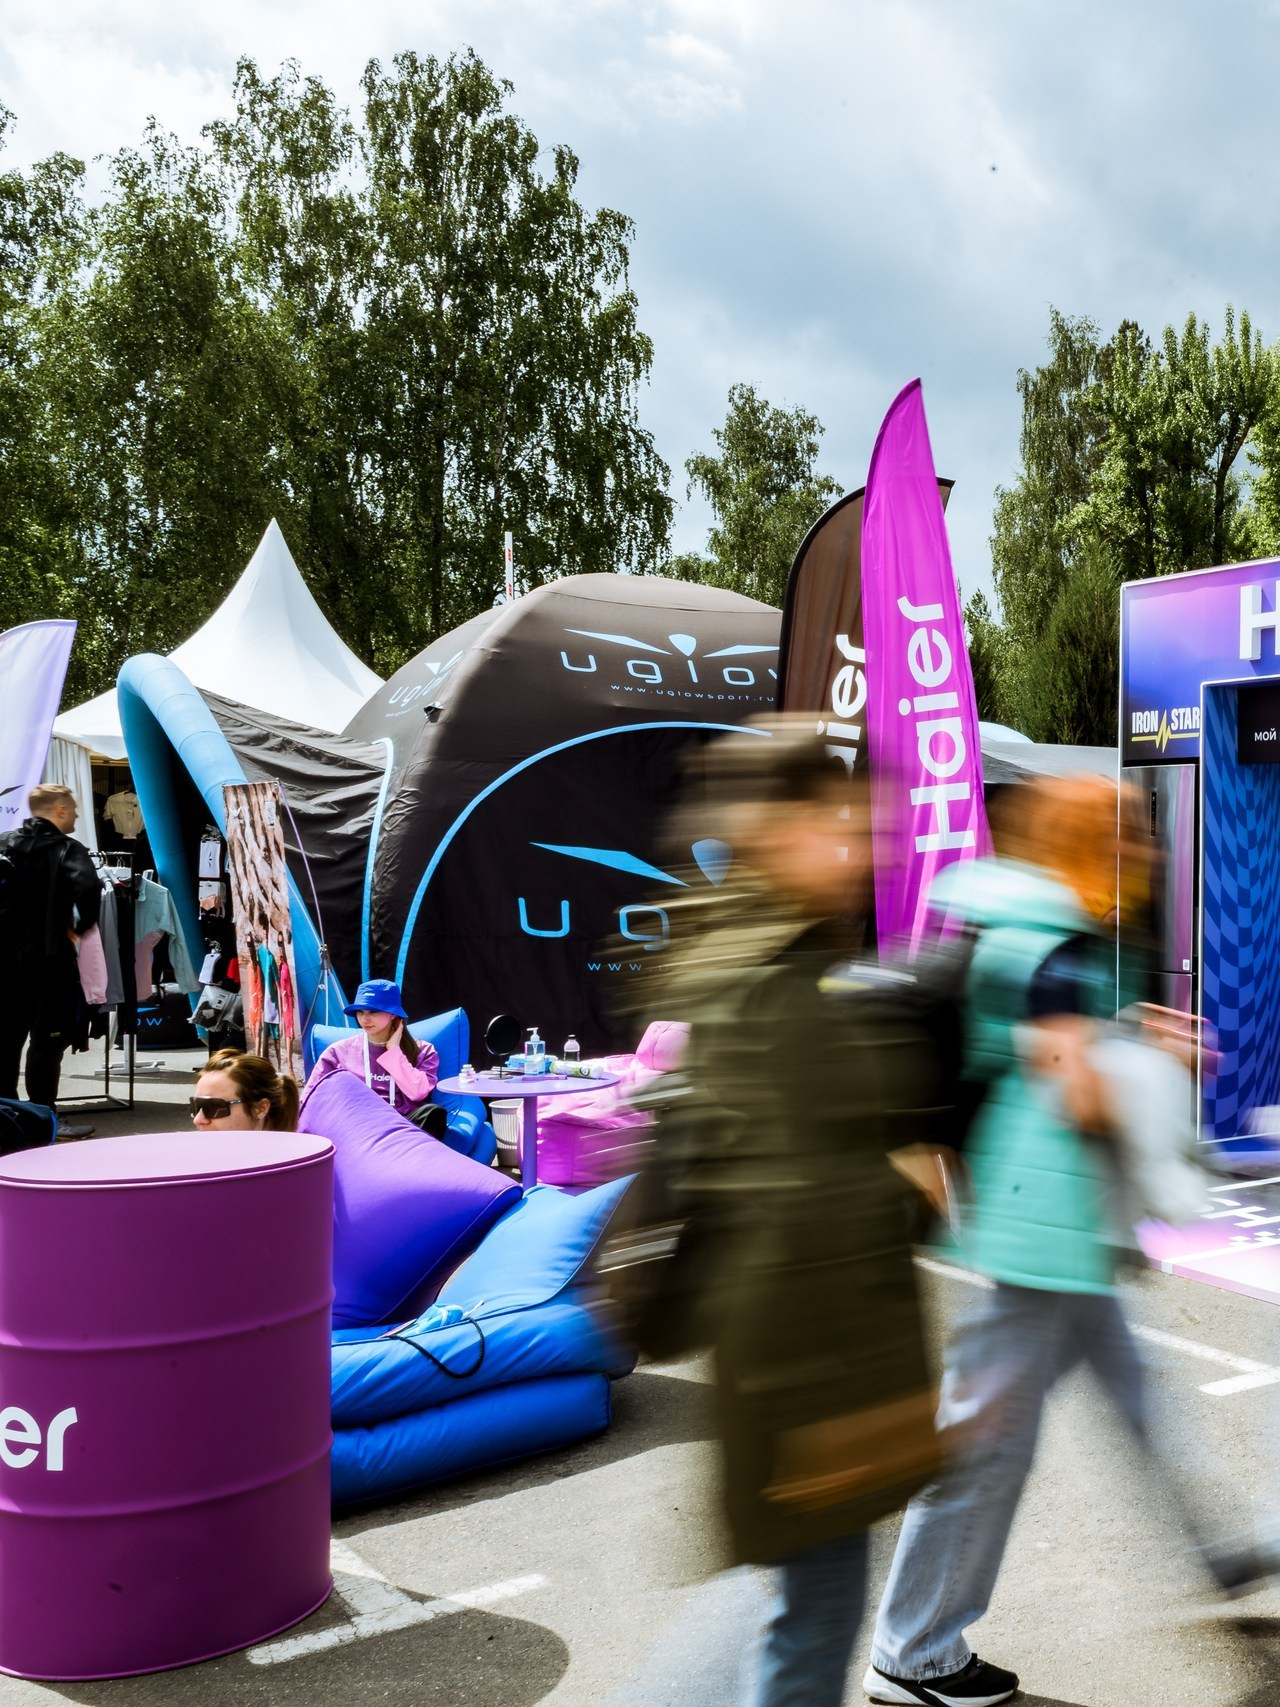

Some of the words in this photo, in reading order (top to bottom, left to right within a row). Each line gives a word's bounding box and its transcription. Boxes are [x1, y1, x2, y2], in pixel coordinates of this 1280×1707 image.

[560, 651, 778, 687] uglo
[610, 684, 775, 703] www.uglowsport.ru
[897, 596, 976, 854] Haier
[1131, 710, 1159, 734] IRON
[1170, 706, 1200, 731] STAR
[1254, 727, 1277, 743] мой
